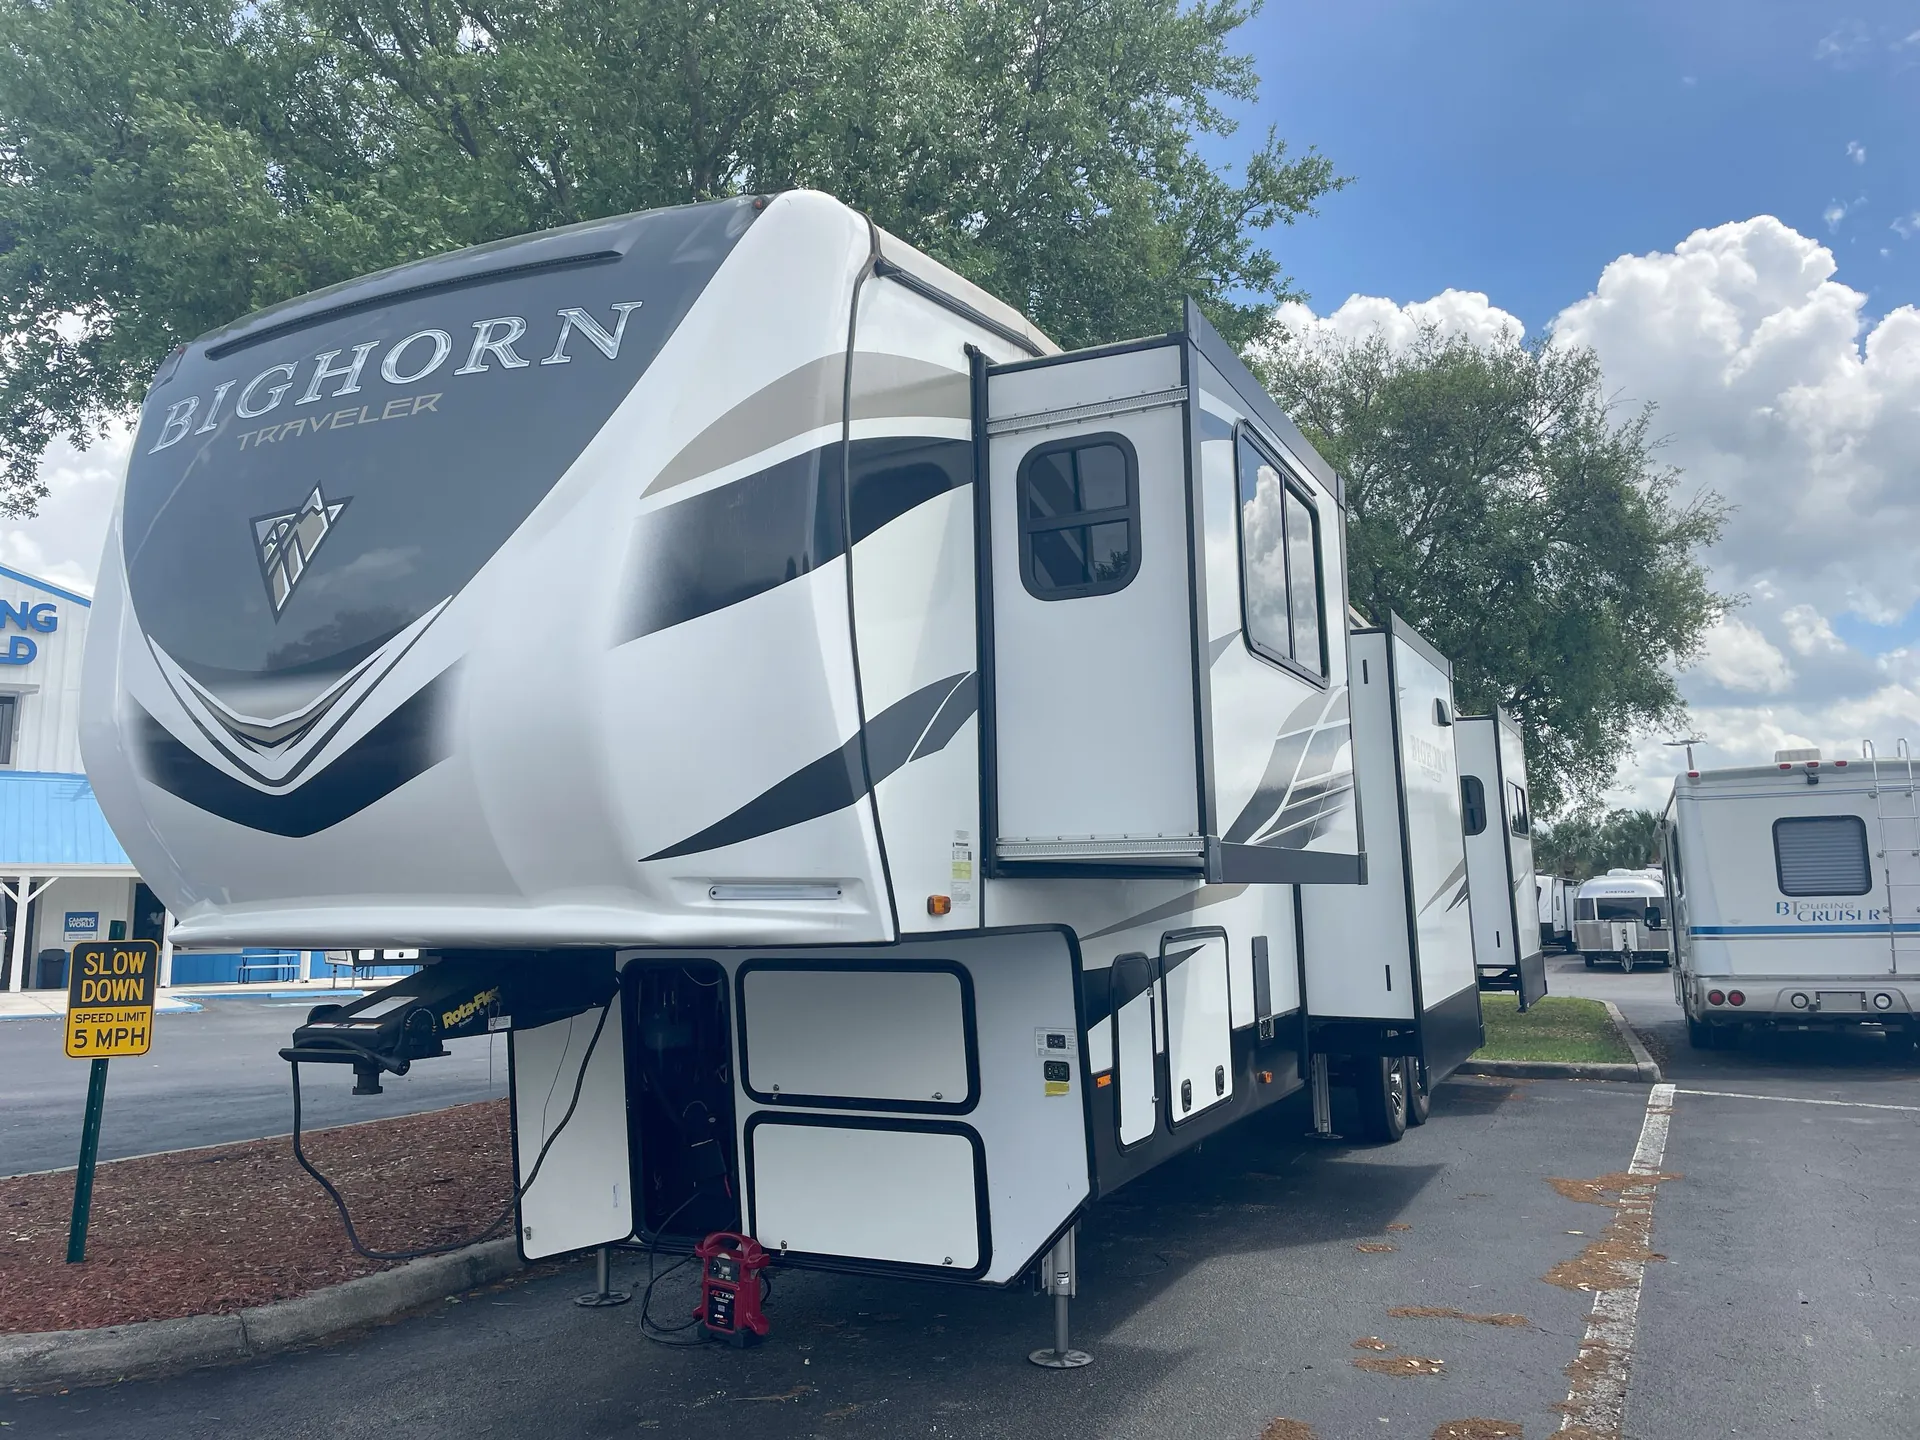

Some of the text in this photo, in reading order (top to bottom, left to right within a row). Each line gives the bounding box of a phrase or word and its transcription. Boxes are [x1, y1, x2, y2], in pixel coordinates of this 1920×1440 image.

[147, 300, 644, 455] BIGHORN
[237, 392, 444, 452] TRAVELER
[84, 951, 147, 976] SLOW
[81, 978, 145, 1003] DOWN
[75, 1011, 147, 1024] SPEED LIMIT
[73, 1027, 146, 1049] 5 MPH
